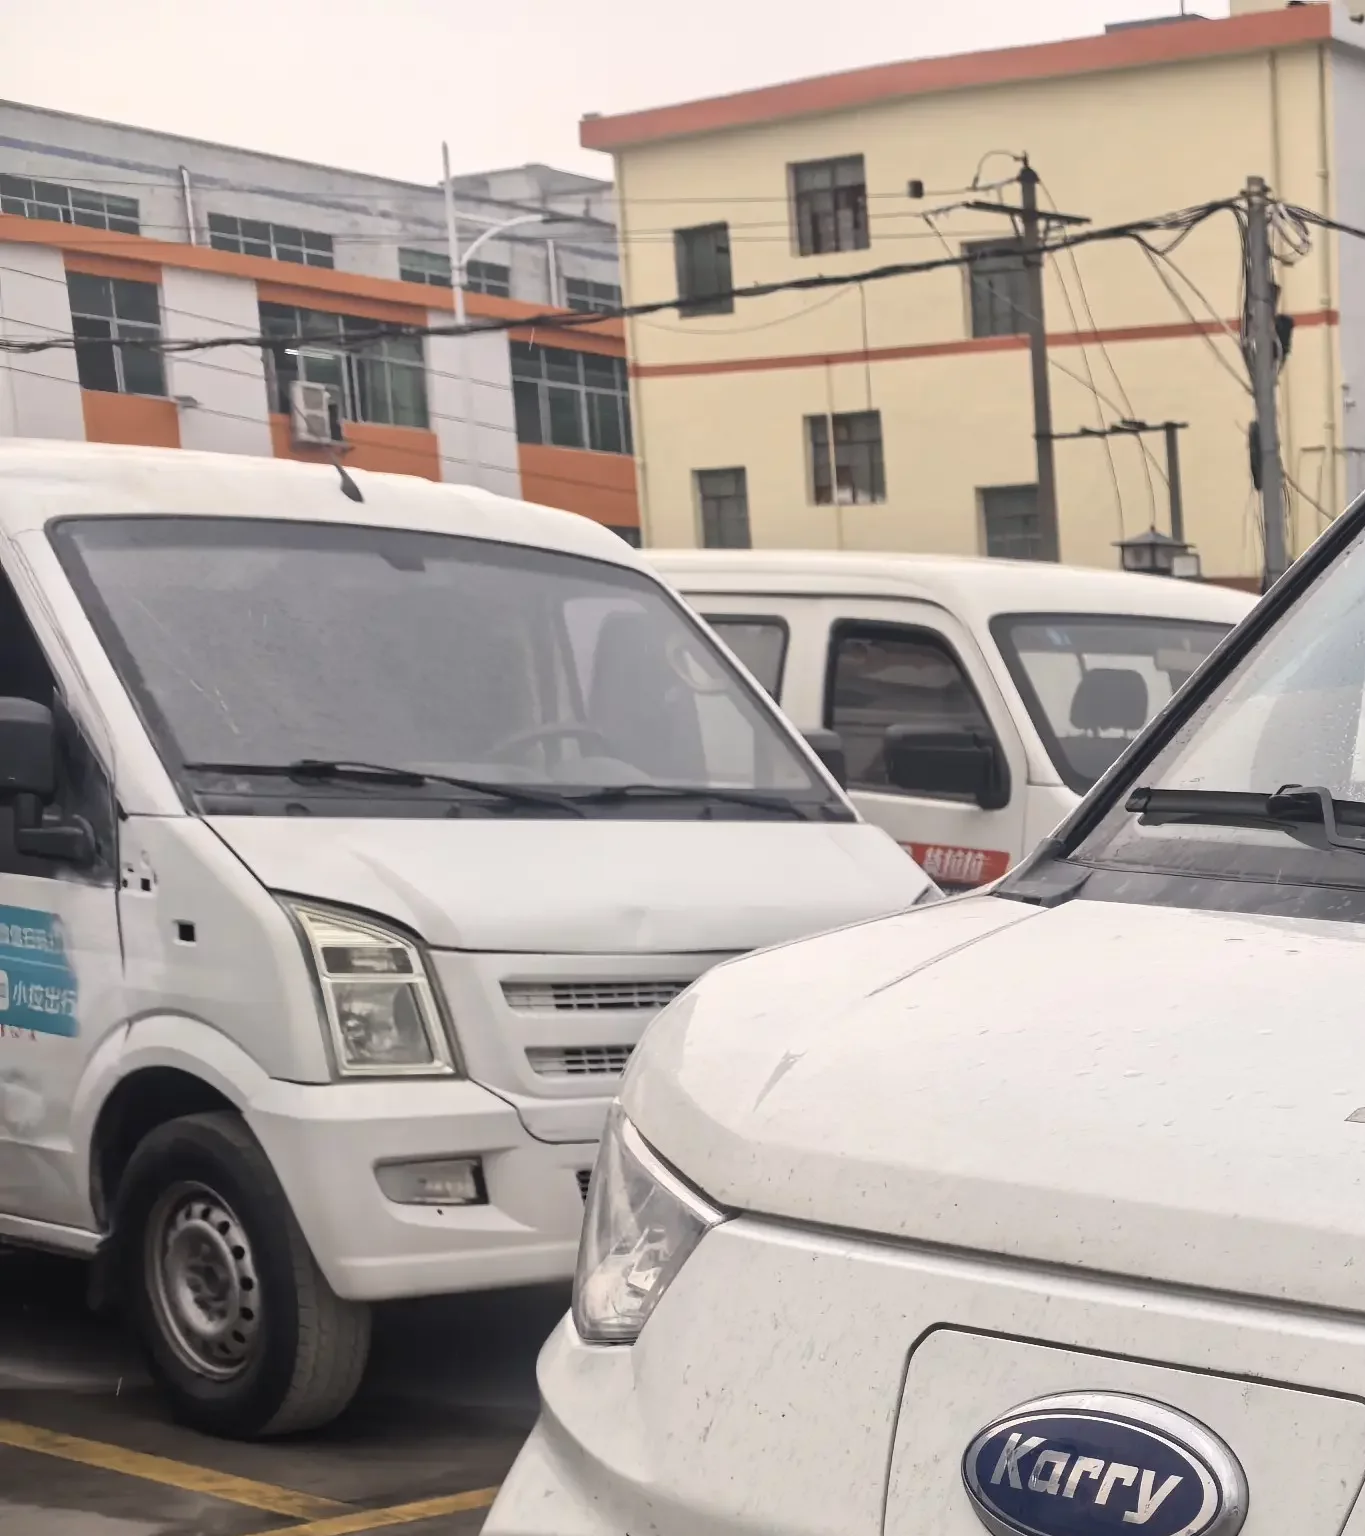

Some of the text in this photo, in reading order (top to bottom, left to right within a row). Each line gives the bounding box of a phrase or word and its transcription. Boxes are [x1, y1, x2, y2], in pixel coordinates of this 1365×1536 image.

[13, 980, 77, 1016] 小拉出行
[989, 1432, 1184, 1524] Karry
